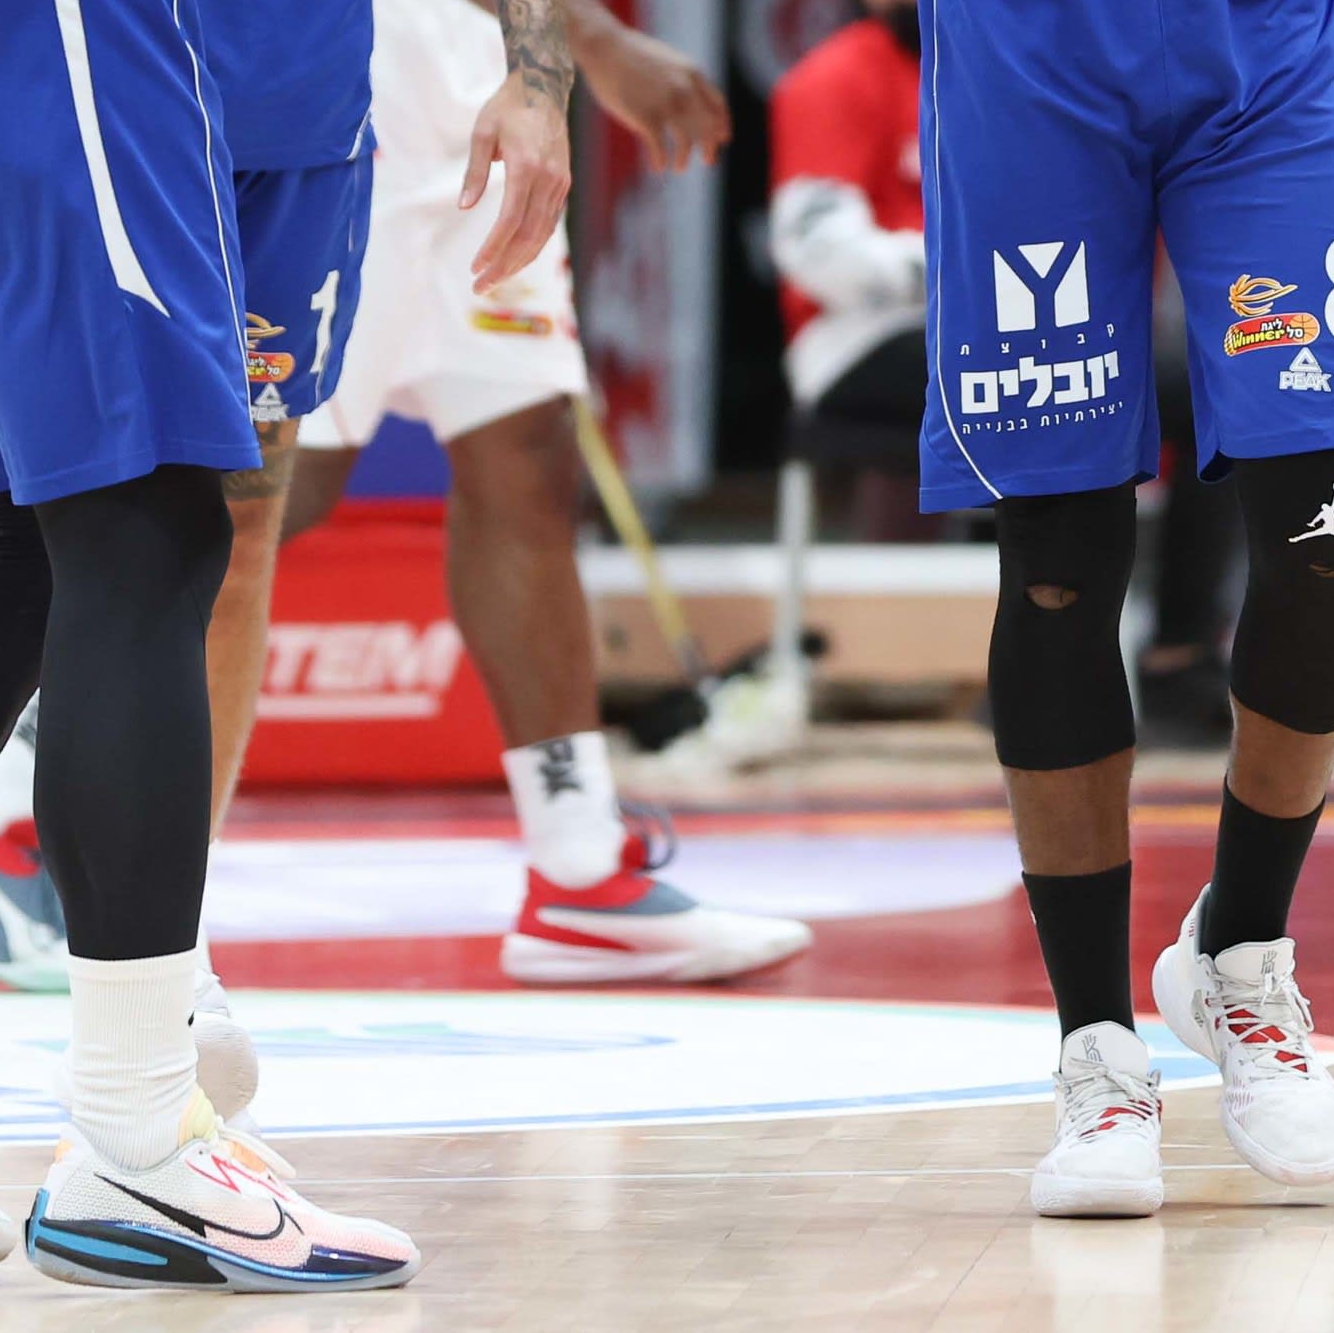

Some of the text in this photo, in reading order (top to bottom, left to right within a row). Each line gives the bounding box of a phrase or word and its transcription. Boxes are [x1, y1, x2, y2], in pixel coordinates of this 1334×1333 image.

[1232, 329, 1286, 349] Winner
[960, 349, 1121, 415] יובלים
[1278, 370, 1332, 393] PEAK
